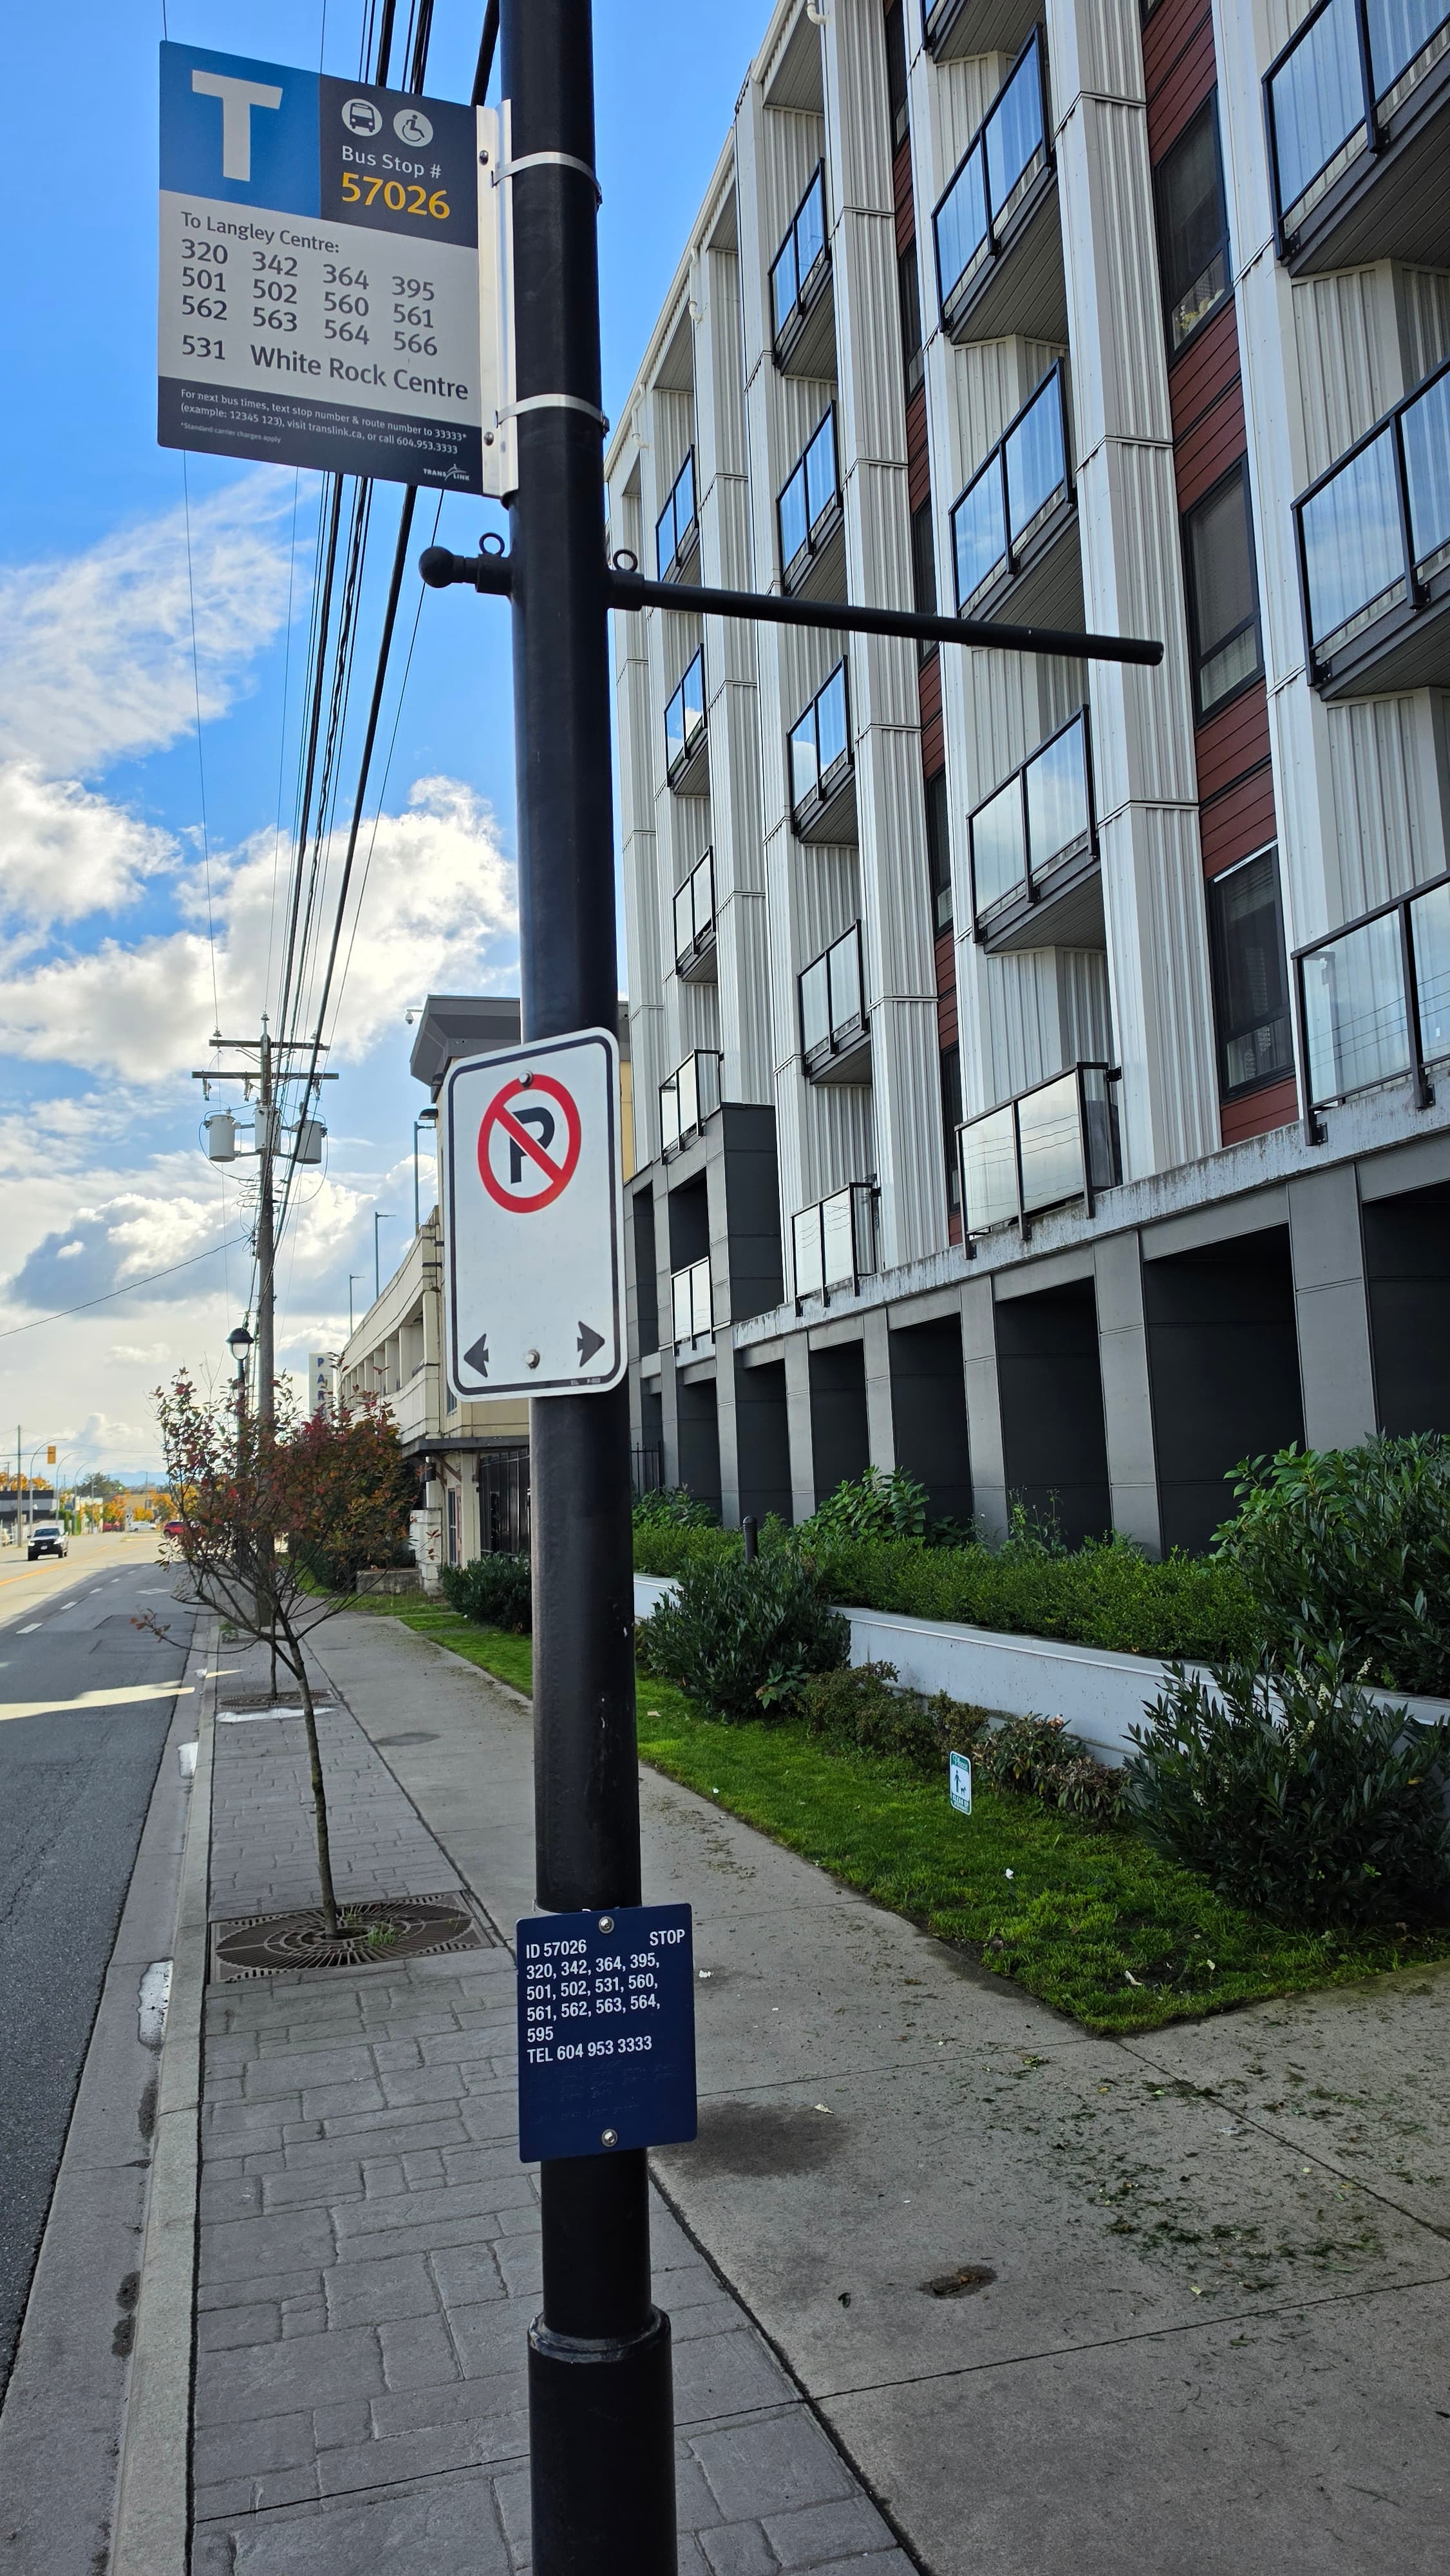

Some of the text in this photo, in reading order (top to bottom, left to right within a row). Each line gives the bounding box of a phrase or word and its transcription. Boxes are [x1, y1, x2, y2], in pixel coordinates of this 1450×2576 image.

[193, 70, 283, 182] T
[342, 146, 442, 178] Bus Stop #
[341, 172, 450, 219] 57026
[182, 211, 339, 253] To Langley Centre:
[181, 239, 435, 301] 320 342 364 395
[182, 267, 434, 328] 501 502 560 561
[182, 295, 438, 357] 562 563 564 566
[182, 335, 469, 401] 531 White Rock Centre
[181, 389, 195, 398] For
[198, 393, 218, 402] next
[221, 395, 238, 405] bus
[241, 398, 269, 412] times,
[272, 403, 290, 413] text
[292, 407, 312, 418] stop
[315, 412, 350, 422] number
[362, 419, 385, 429] route
[388, 422, 422, 435] number
[424, 428, 433, 437] to
[181, 402, 458, 454] (example: 12345 123), visit translink.ca, or call 604.953.3333
[237, 431, 261, 440] charges
[510, 1106, 555, 1184] P
[526, 1929, 685, 1958] ID 57026 STOP
[526, 1953, 660, 1980] 320, 342, 364, 395,
[527, 1973, 658, 2001] 501, 502, 531, 560,
[527, 1993, 660, 2022] 561, 562, 563, 564,
[527, 2026, 554, 2043] 595
[527, 2035, 652, 2063] TEL 604 953 3333
